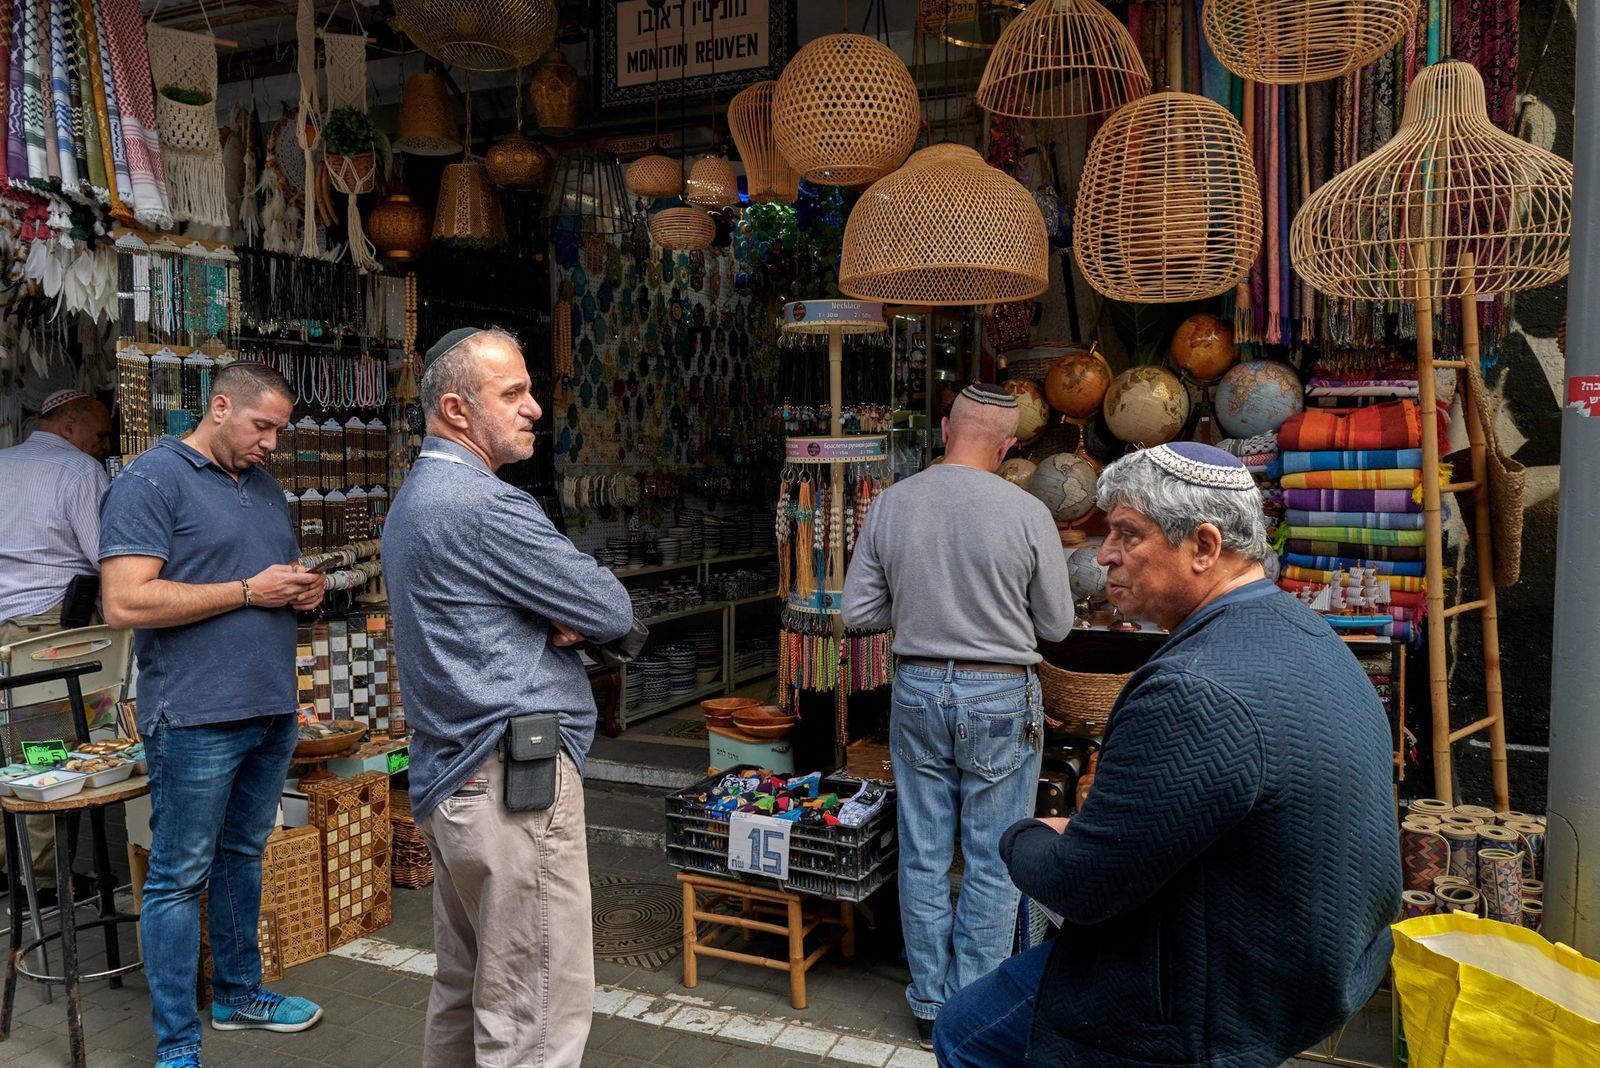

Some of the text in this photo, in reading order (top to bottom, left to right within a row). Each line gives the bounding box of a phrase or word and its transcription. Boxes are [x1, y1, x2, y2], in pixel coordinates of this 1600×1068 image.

[638, 4, 685, 35] ראובן
[627, 32, 759, 74] MONITIN REUVEN
[831, 302, 861, 310] Necklace
[747, 828, 784, 875] 15
